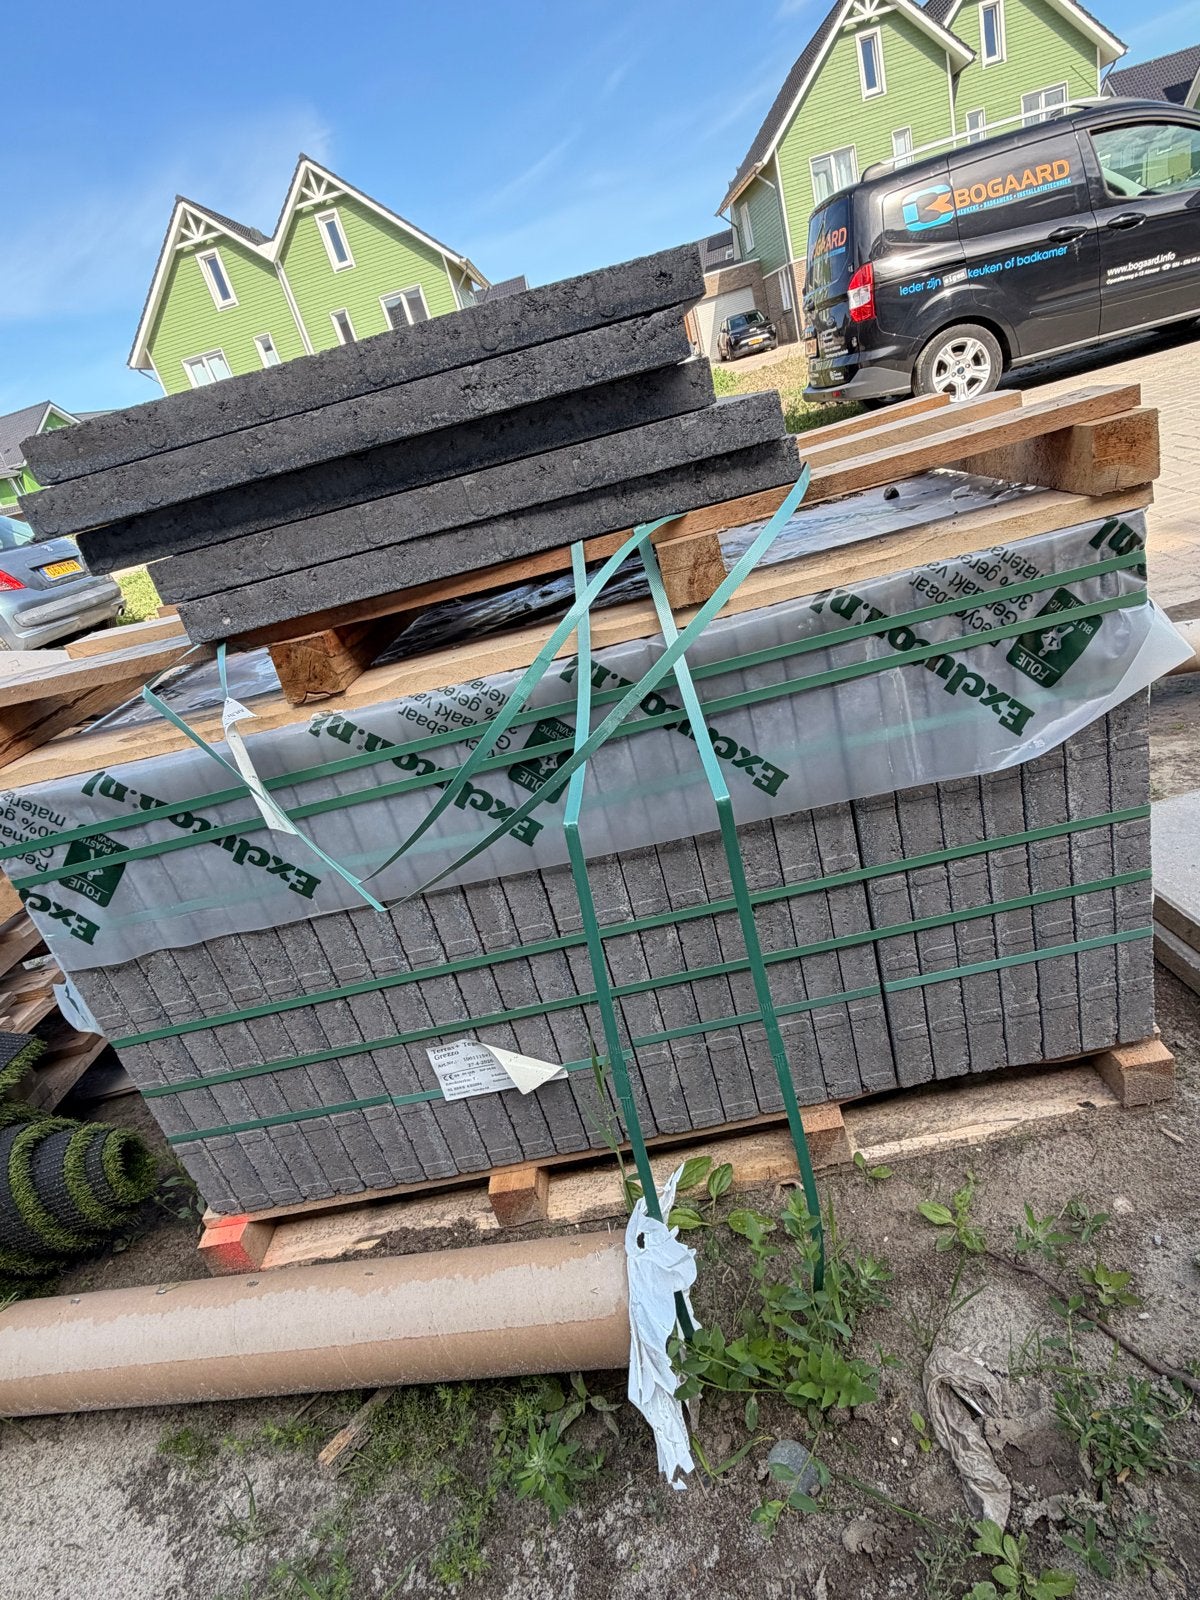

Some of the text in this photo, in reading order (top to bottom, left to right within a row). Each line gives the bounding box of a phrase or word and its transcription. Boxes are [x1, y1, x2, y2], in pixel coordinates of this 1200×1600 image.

[953, 159, 1071, 208] BOGAARD
[926, 277, 942, 291] zijn
[967, 262, 1003, 279] keuken
[1004, 256, 1016, 269] of
[1016, 245, 1069, 267] badkamer
[1106, 250, 1177, 277] www.bogaard.info
[1015, 651, 1050, 682] FOLIE
[68, 876, 102, 902] FOLIE
[433, 1050, 460, 1061] Grezzo
